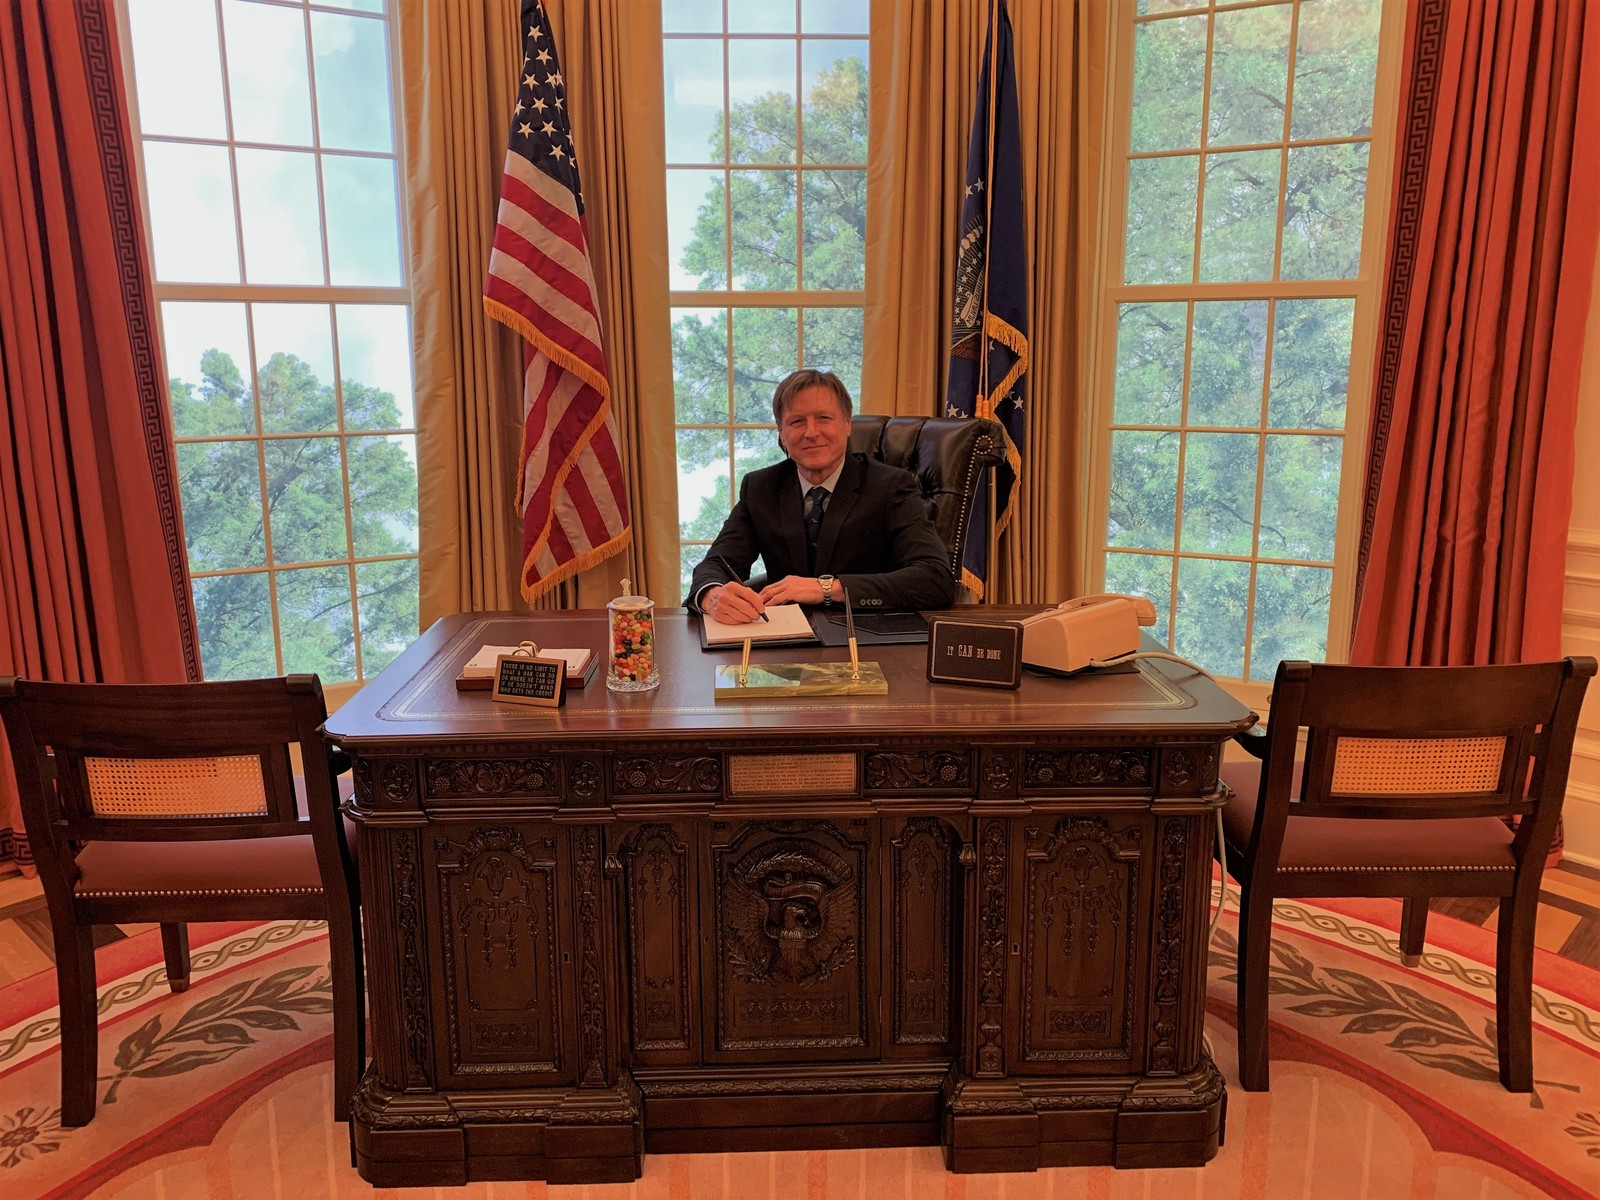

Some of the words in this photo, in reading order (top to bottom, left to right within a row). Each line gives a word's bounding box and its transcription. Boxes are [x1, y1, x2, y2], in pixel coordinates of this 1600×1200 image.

[947, 646, 953, 655] IT
[958, 645, 973, 657] CAN
[977, 648, 984, 658] BE
[987, 649, 1001, 660] DONE
